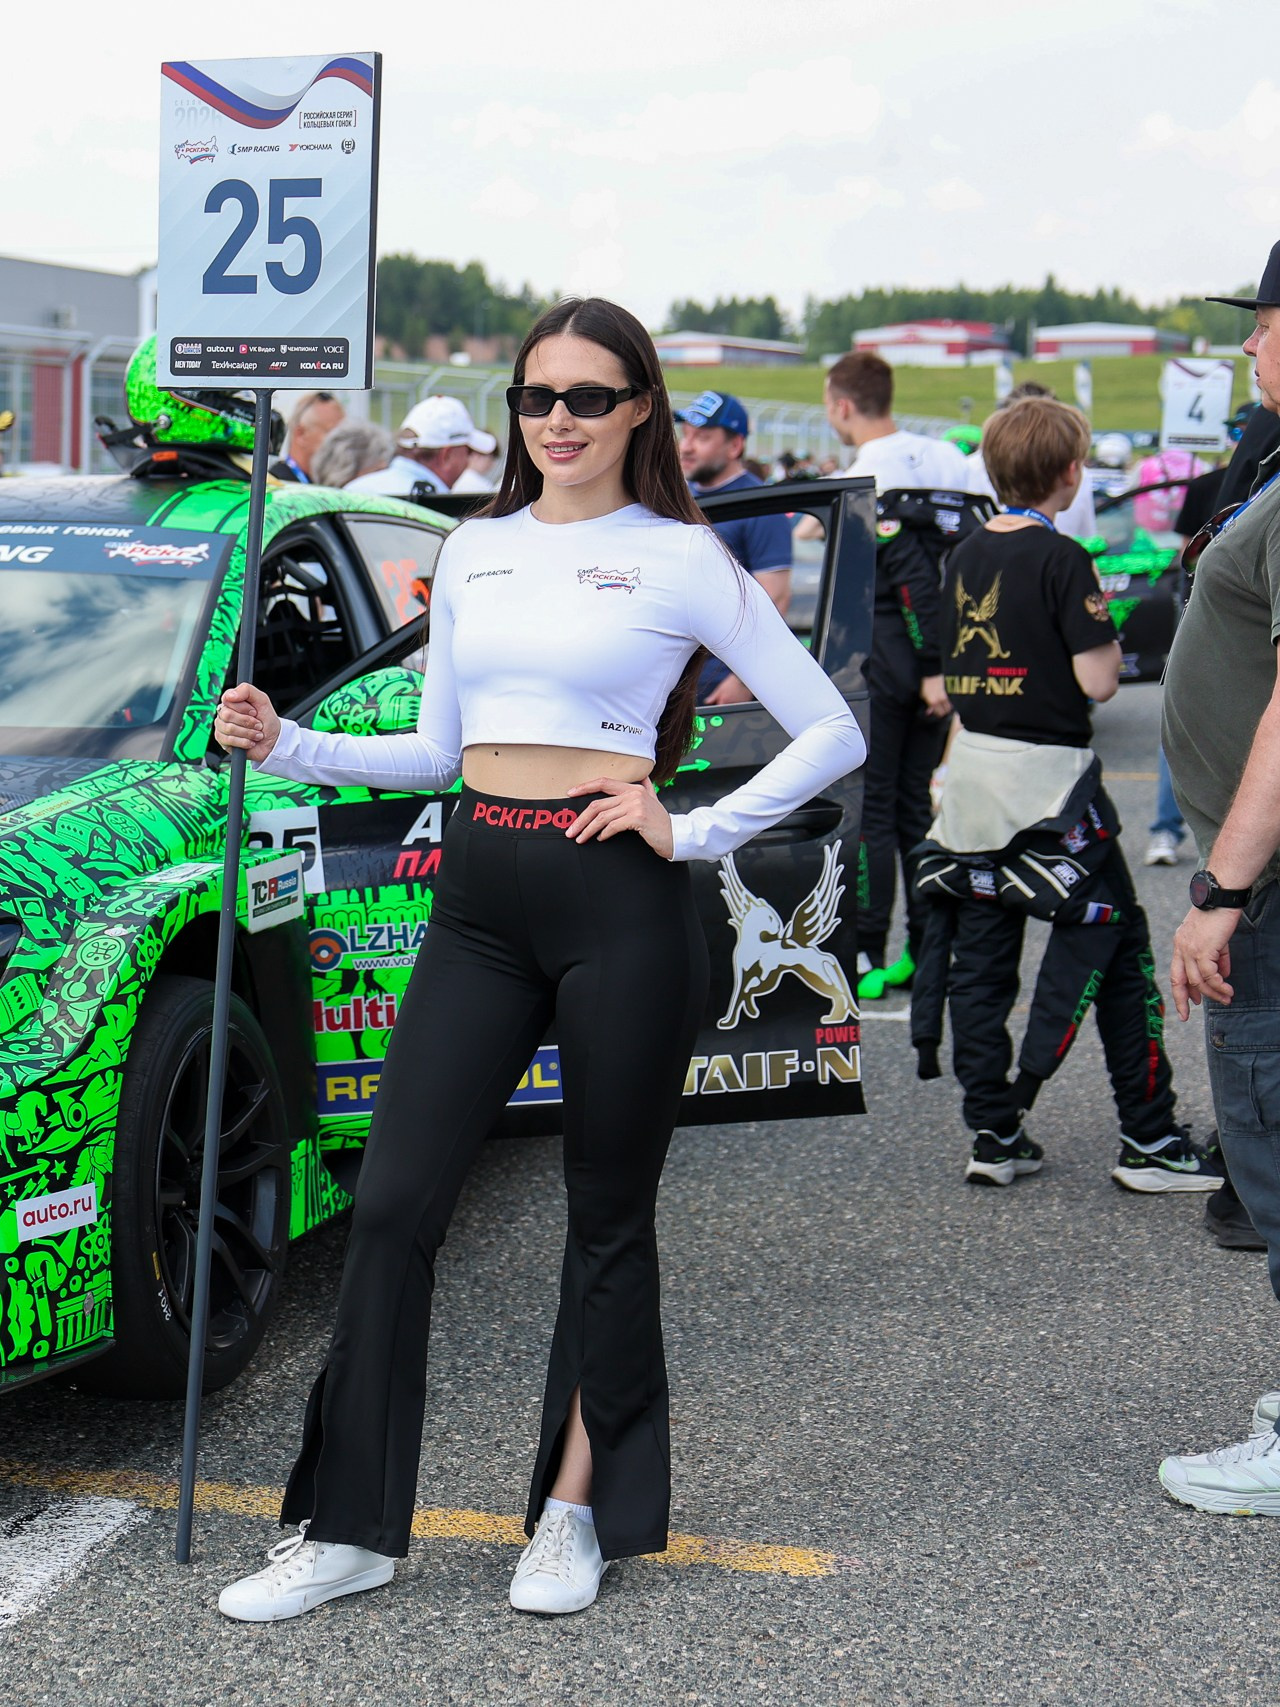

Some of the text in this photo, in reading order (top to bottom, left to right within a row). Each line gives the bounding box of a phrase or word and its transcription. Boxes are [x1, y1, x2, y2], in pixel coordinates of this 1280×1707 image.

[303, 110, 353, 120] РОССИЙСКАЯ СЕРИЯ
[303, 120, 352, 129] КОЛЬЦЕВЫХ ГОНОК
[299, 143, 333, 151] YOKOHAMA
[202, 178, 323, 295] 25
[206, 345, 235, 353] auto.ru
[257, 346, 276, 354] Видео
[323, 345, 345, 353] VOICE
[174, 360, 202, 369] MEN TODAY
[211, 361, 258, 371] ТехИнсайдер
[1187, 393, 1204, 423] 4
[62, 526, 134, 538] гонок
[486, 568, 514, 577] RACING
[592, 573, 629, 582] РСКГ.РФ
[472, 801, 579, 831] РСКГ.РФ
[251, 875, 297, 906] TCR Russia
[354, 954, 418, 970] www.vol
[815, 1025, 860, 1045] POWE
[22, 1193, 95, 1230] auto.ru
